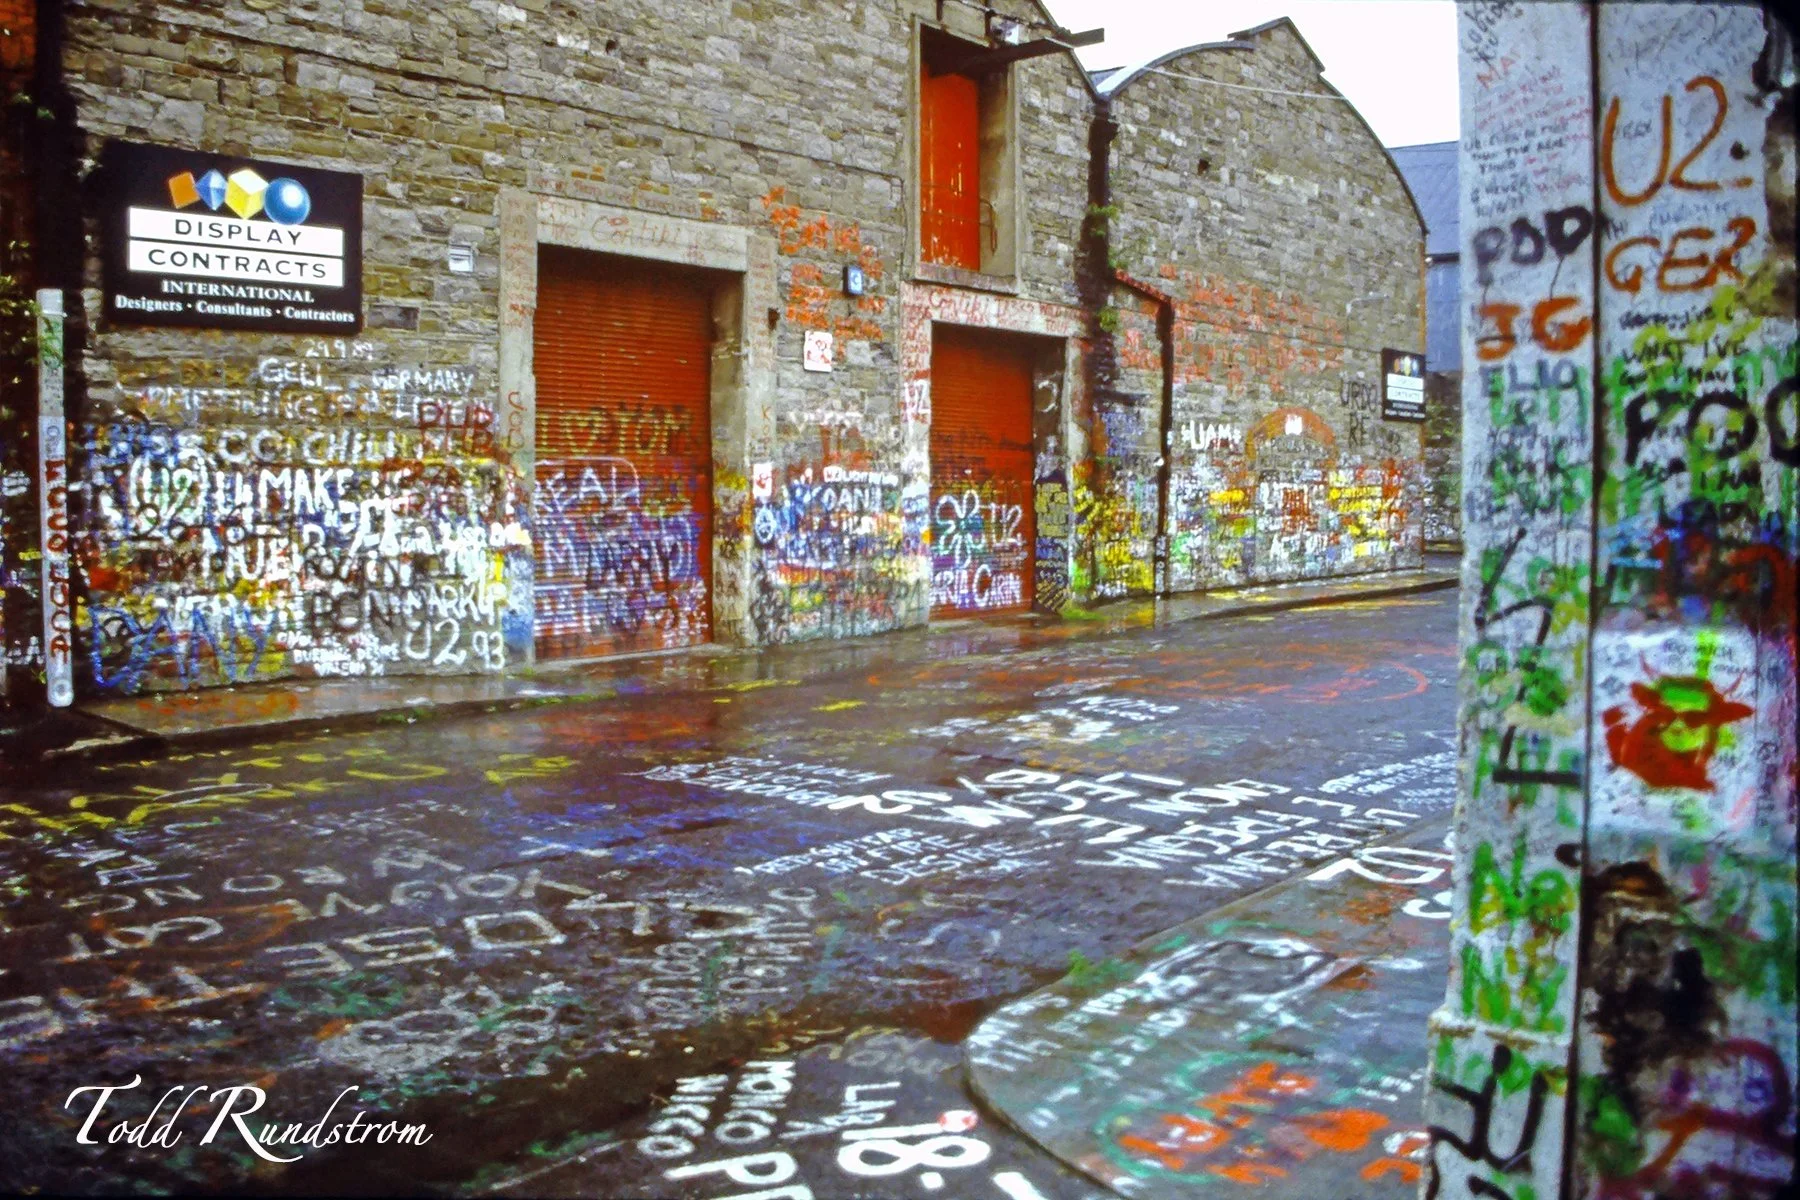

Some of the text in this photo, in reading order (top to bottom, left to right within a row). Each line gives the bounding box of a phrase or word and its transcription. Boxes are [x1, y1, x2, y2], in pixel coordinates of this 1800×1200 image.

[174, 218, 304, 247] DISPLAY
[147, 248, 328, 280] CONTRACTS
[161, 280, 315, 303] INTERNATIONAL
[115, 294, 356, 324] Designers Consultants Contractors
